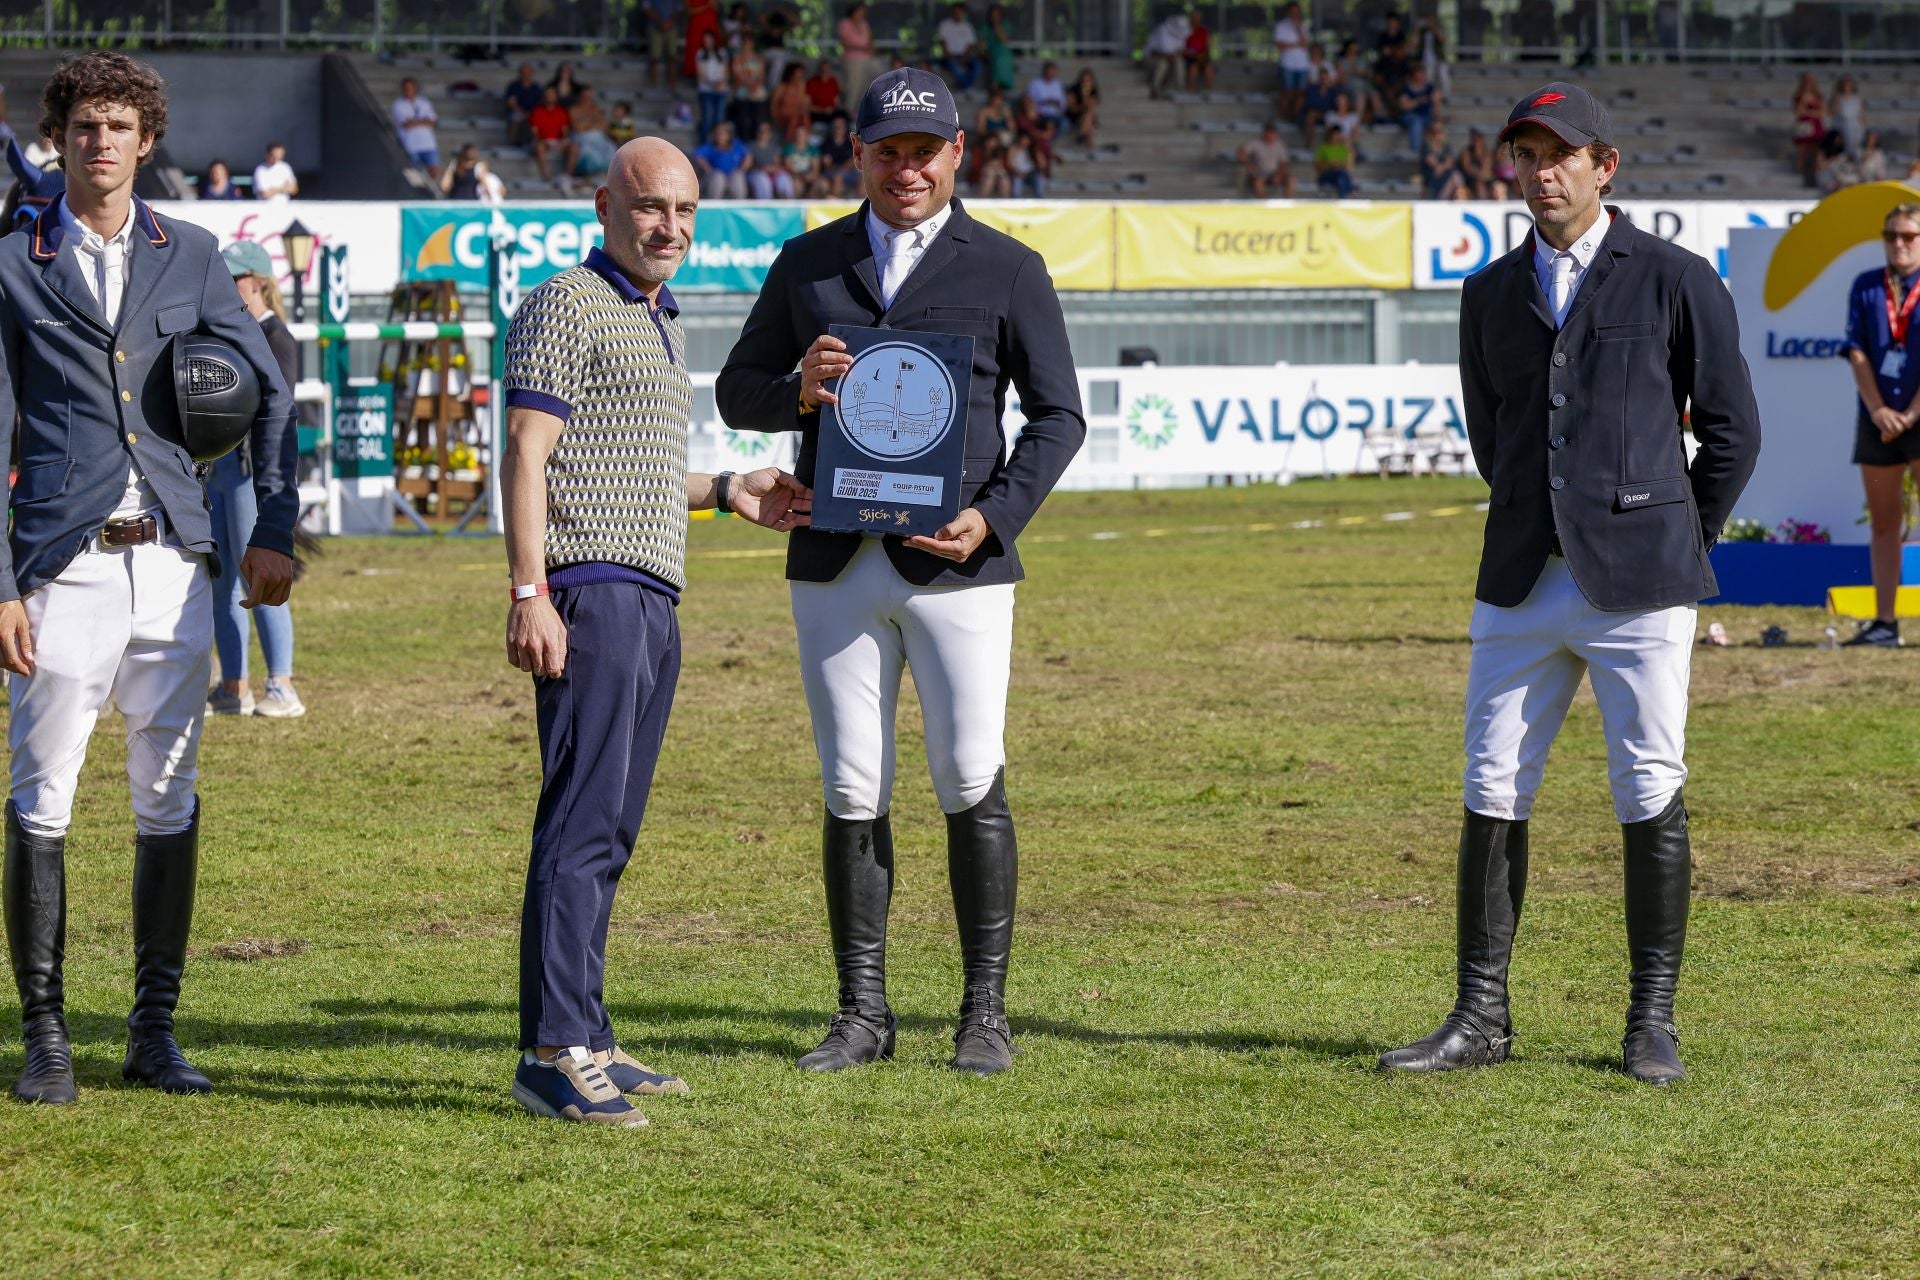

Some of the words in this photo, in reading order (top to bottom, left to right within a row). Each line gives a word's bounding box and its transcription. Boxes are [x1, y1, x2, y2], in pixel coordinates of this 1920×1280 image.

[883, 89, 937, 108] JAC
[1195, 223, 1297, 255] Lacera
[1766, 331, 1848, 359] Lacer
[1192, 397, 1468, 442] VALORIZA
[836, 485, 859, 496] GIJÓN
[858, 488, 879, 498] 2025
[839, 478, 881, 489] INTERNACIONAL
[859, 508, 891, 522] gijón
